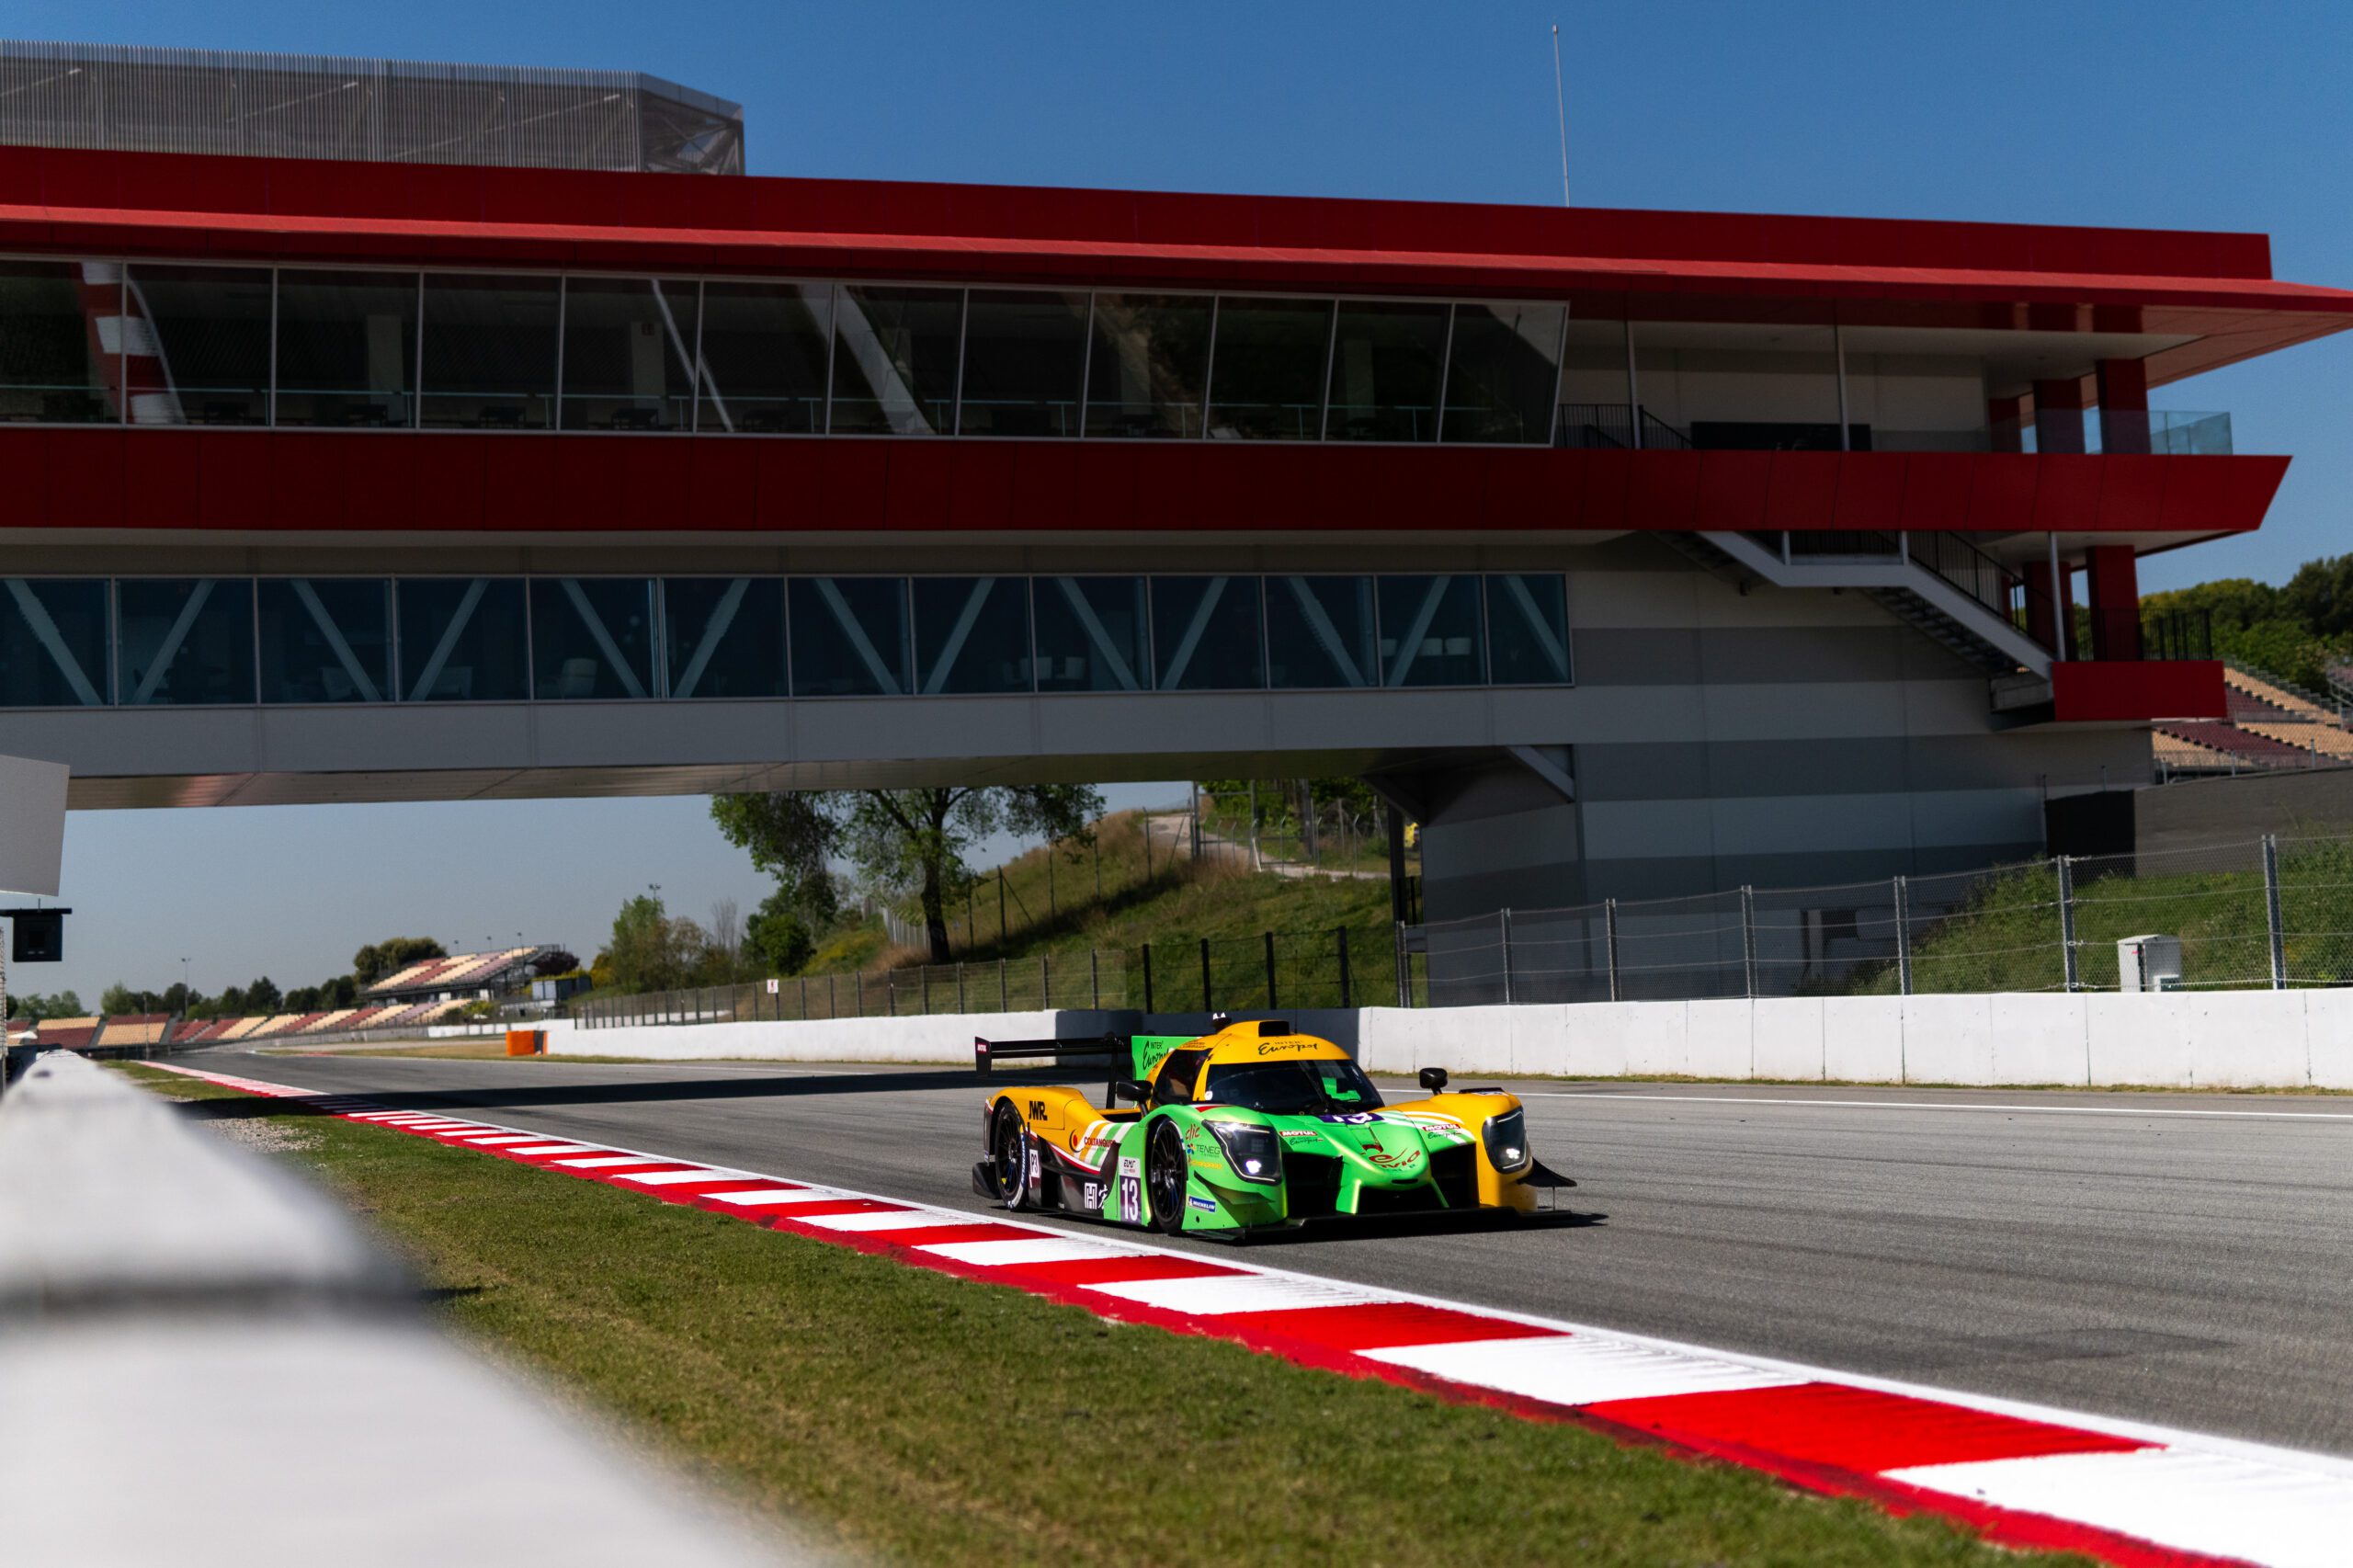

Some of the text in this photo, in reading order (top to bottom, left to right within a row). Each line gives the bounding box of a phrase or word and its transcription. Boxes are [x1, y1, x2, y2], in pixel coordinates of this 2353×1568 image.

[1030, 1153, 1039, 1175] P3
[1121, 1177, 1139, 1221] 13
[1192, 1199, 1215, 1210] MICHELIN
